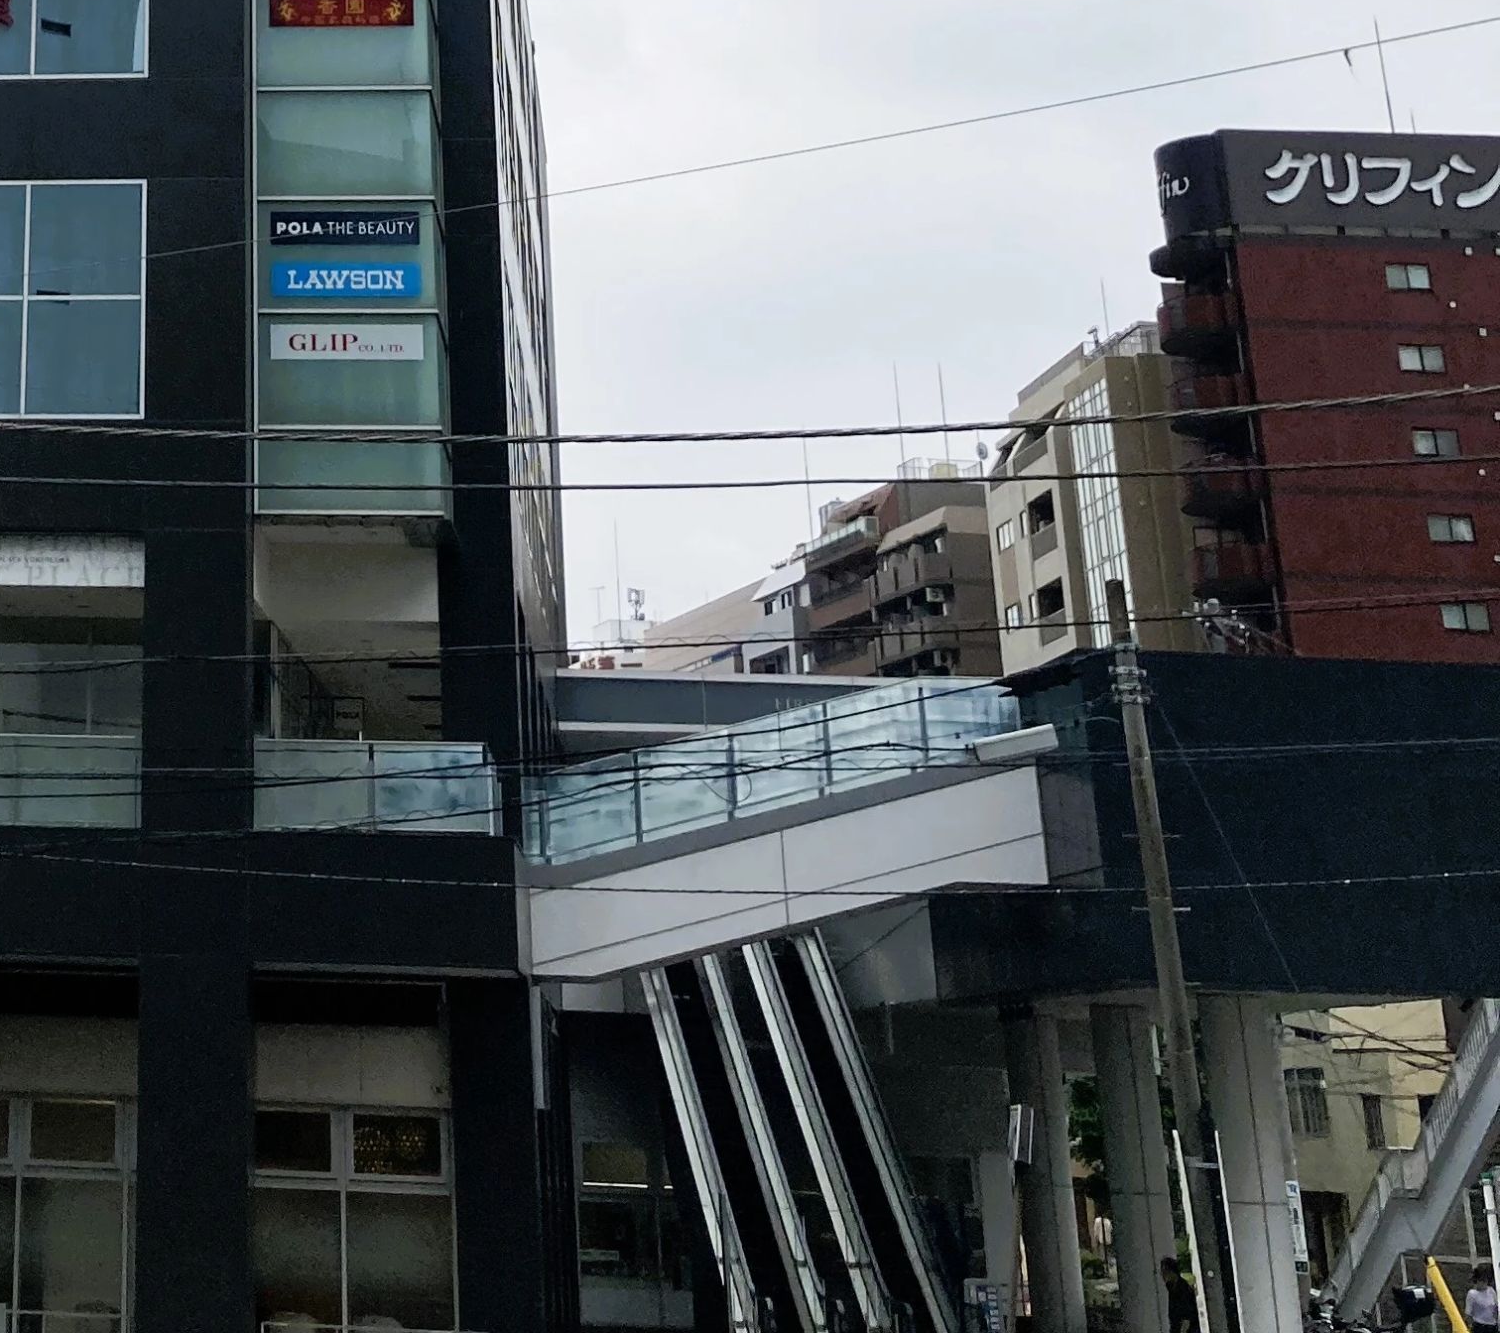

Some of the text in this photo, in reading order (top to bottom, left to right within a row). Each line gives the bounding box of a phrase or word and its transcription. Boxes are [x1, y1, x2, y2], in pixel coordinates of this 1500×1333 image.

[1264, 148, 1500, 209] グリフィン
[276, 221, 415, 235] POLA THE BEAUTY
[287, 270, 404, 289] LAWSON
[288, 334, 358, 352] GLIP
